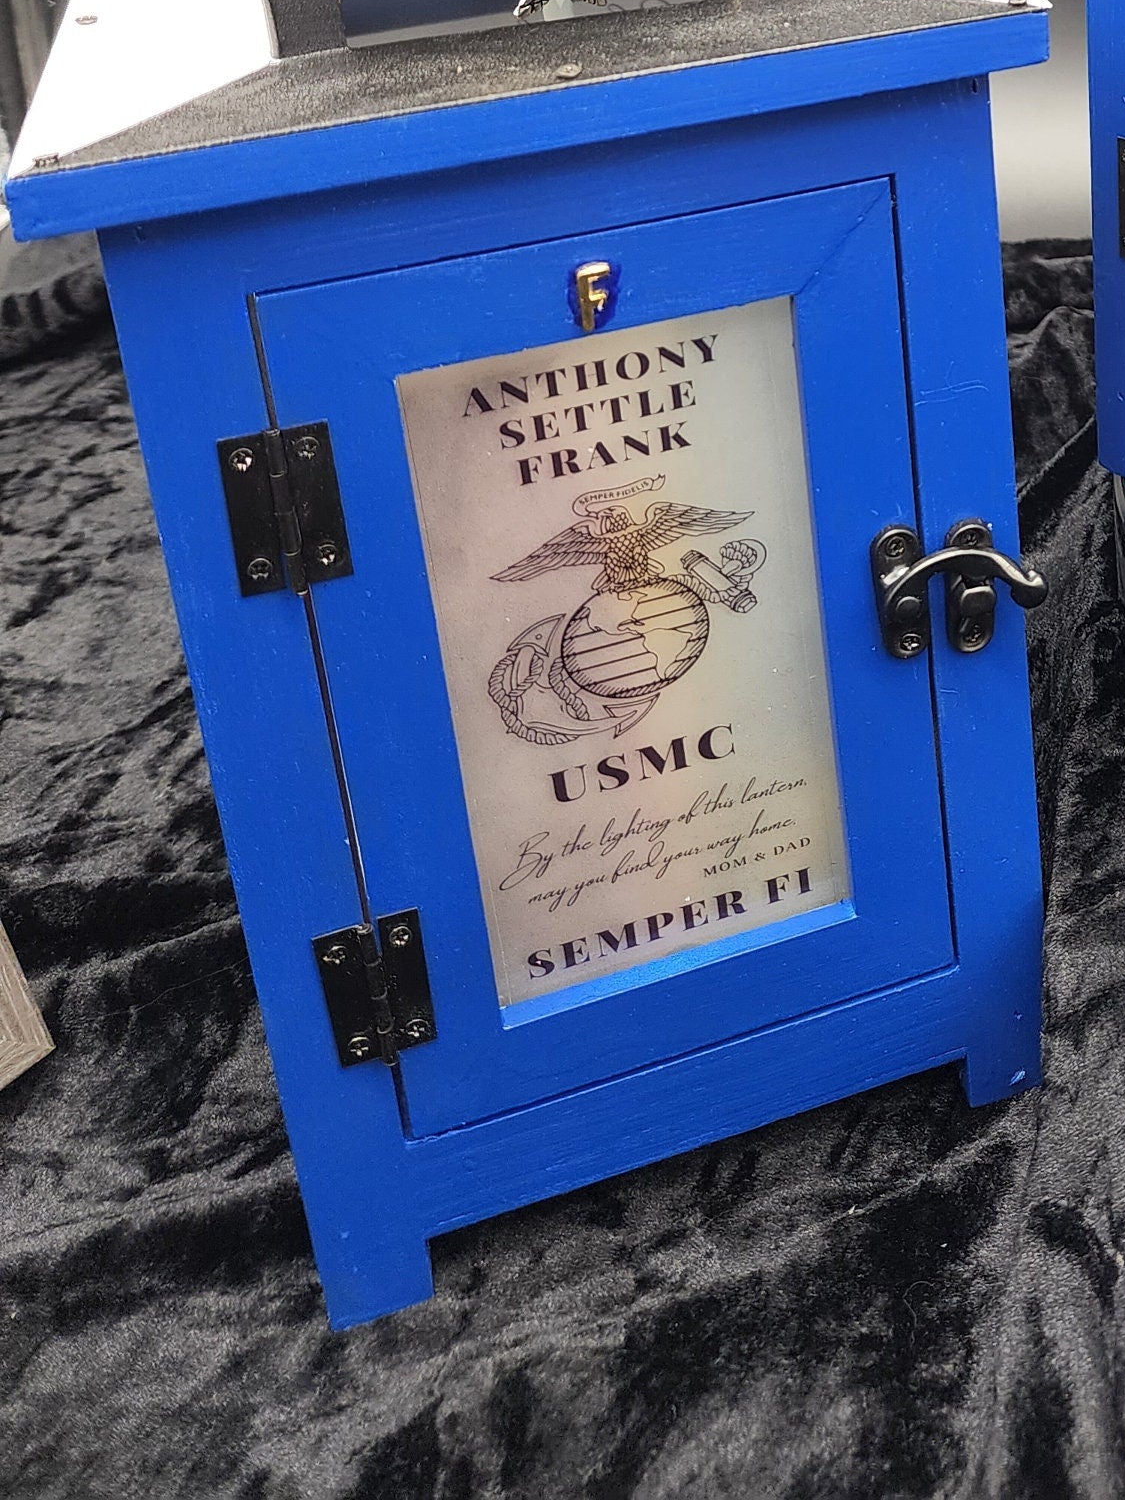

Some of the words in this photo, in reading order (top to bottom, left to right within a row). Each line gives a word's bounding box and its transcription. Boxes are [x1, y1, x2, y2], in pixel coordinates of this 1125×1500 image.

[576, 261, 611, 331] F
[462, 334, 718, 417] ANTHONY
[500, 381, 697, 450] SETTLE
[516, 421, 692, 486] FRANK
[579, 492, 614, 504] SEMPER
[616, 481, 649, 497] FIDELIS
[547, 723, 736, 803] USMC
[500, 832, 554, 890] By
[562, 824, 593, 857] the
[600, 808, 671, 856] lighting
[677, 790, 708, 824] of
[704, 783, 735, 814] this
[528, 886, 566, 911] may
[567, 875, 606, 906] you
[612, 841, 664, 883] find
[656, 846, 700, 879] your
[707, 834, 742, 858] way
[749, 809, 797, 838] home.
[703, 856, 747, 877] MOM
[754, 852, 766, 861] &
[774, 837, 811, 856] DAD
[527, 890, 748, 979] SEMPER
[765, 867, 813, 904] FI
